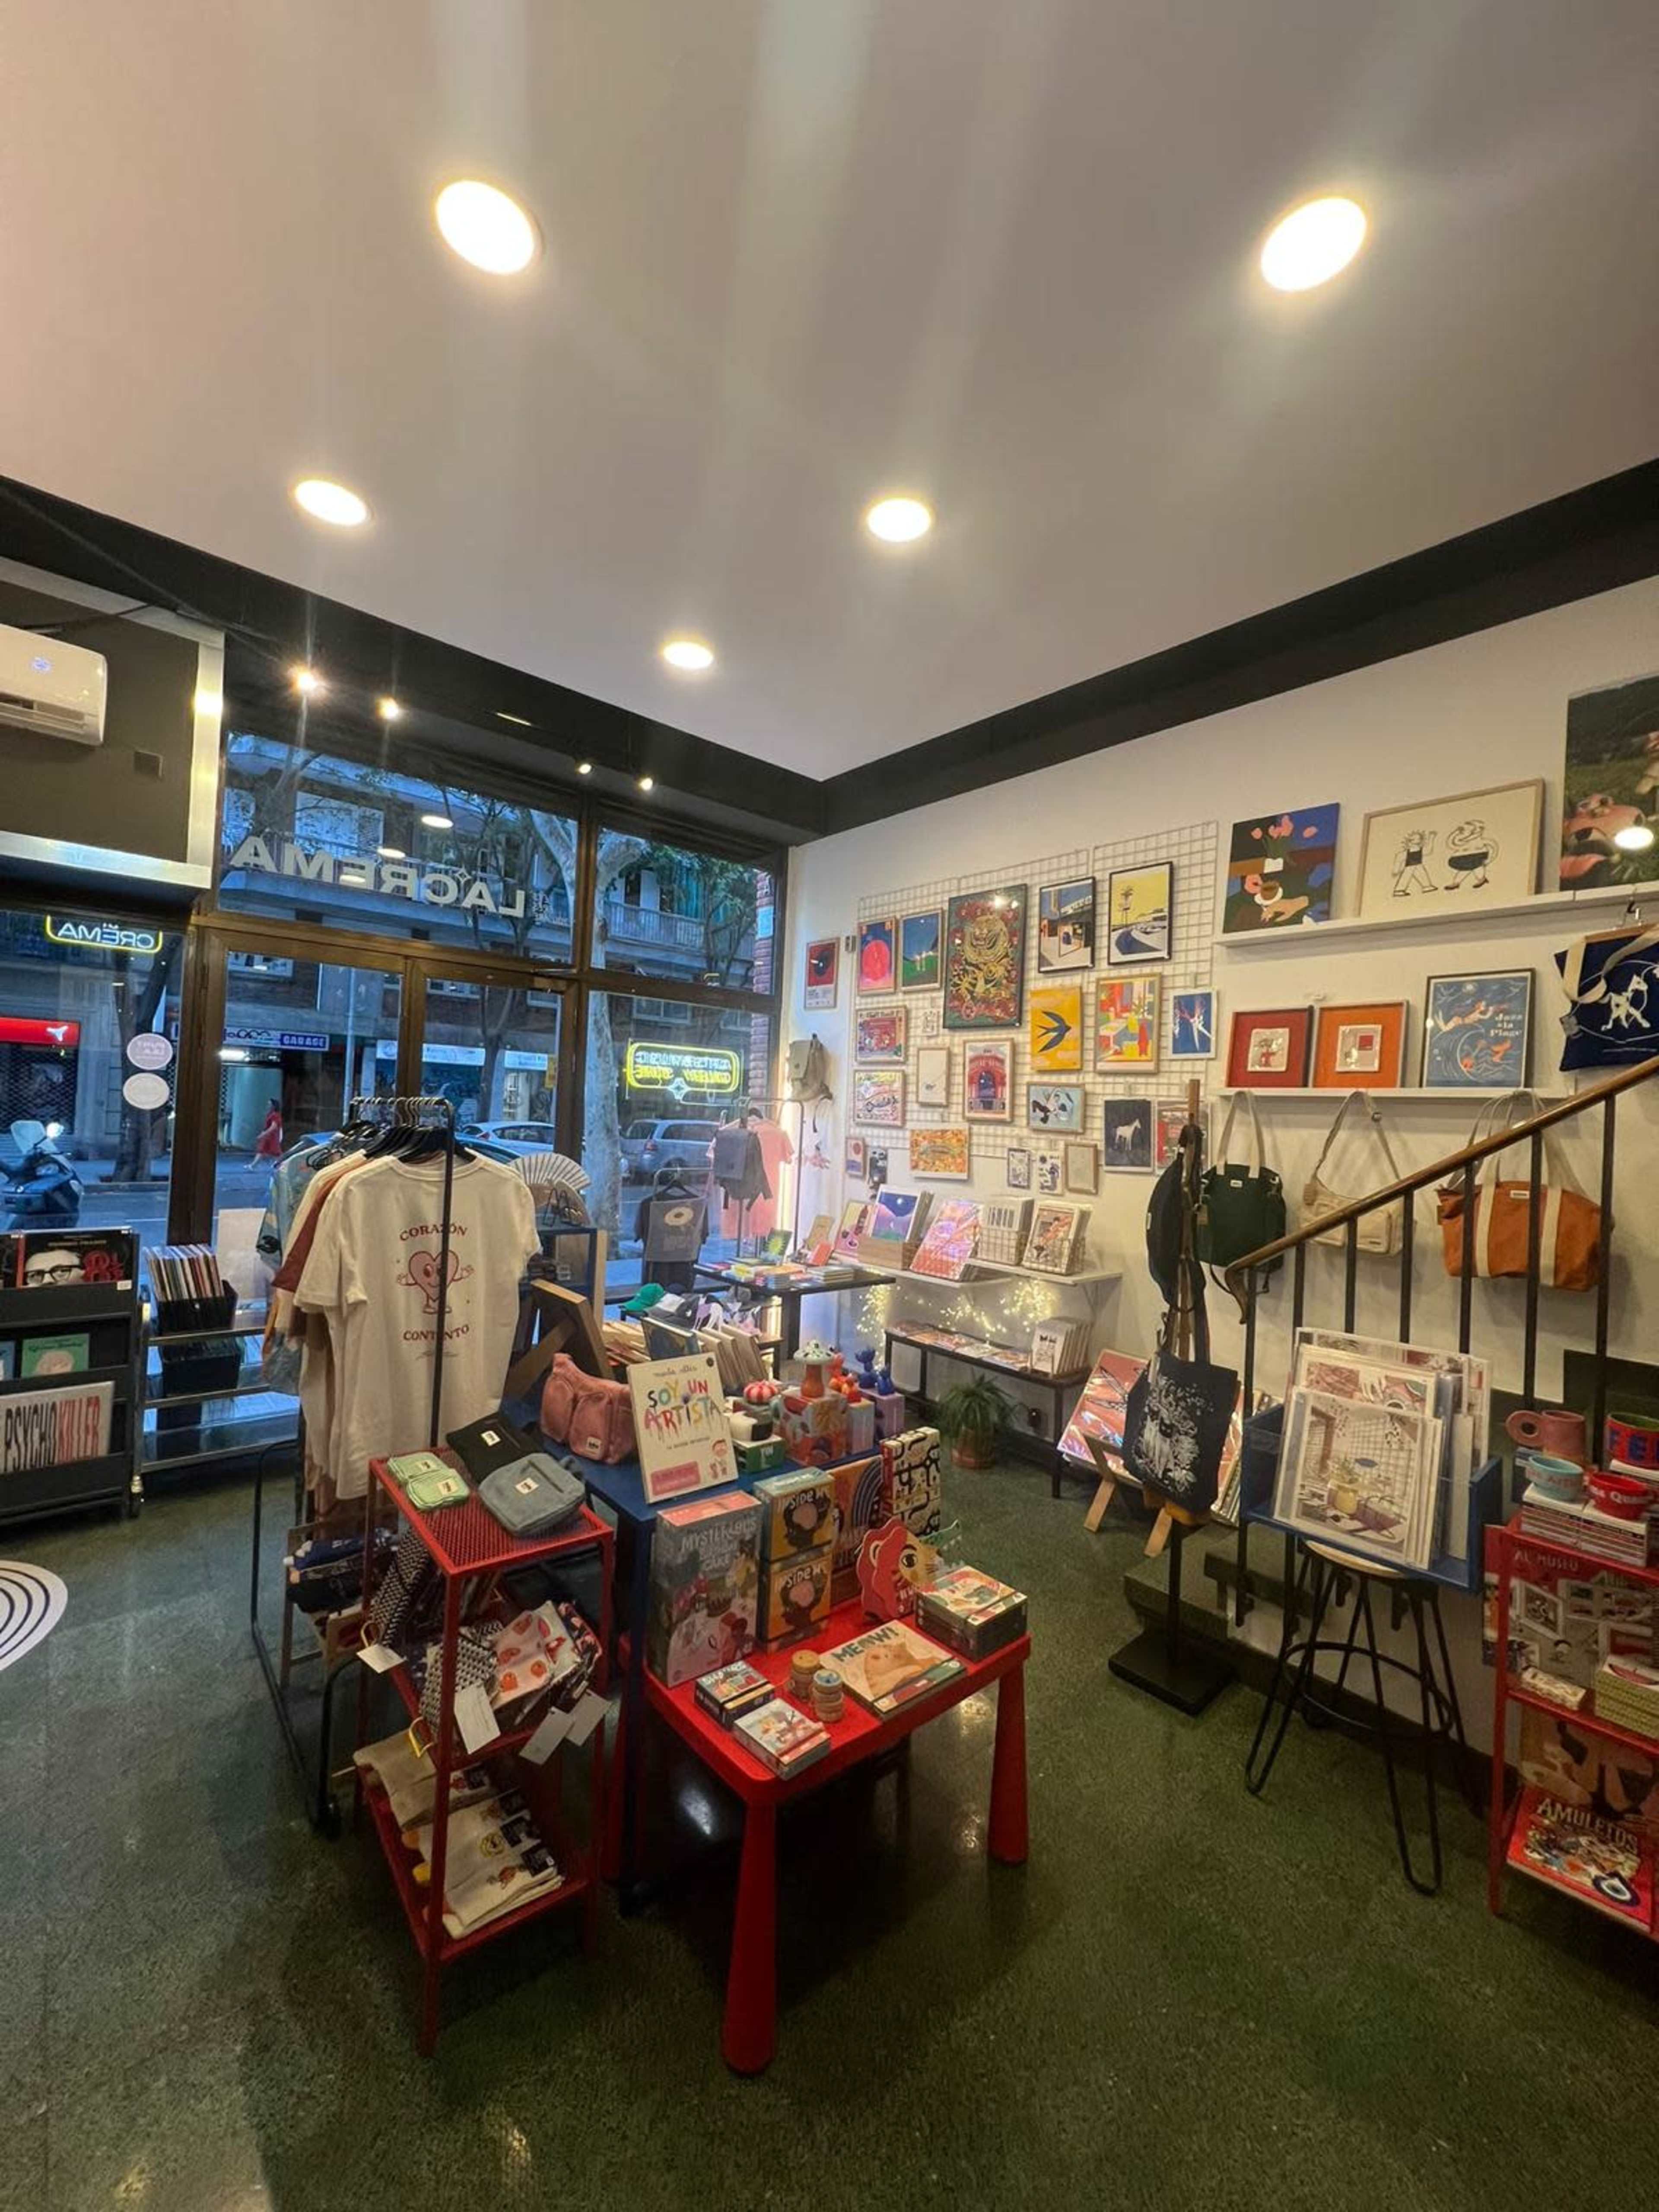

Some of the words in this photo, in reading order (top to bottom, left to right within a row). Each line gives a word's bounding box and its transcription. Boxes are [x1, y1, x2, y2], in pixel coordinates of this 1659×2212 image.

[403, 1324, 470, 1341] CONTNTO
[647, 1378, 680, 1408] SOY
[686, 1378, 709, 1395] UN
[643, 1395, 722, 1433] ARTISTA
[831, 1626, 899, 1662] MEOW!
[1536, 1798, 1638, 1855] AMULETOS
